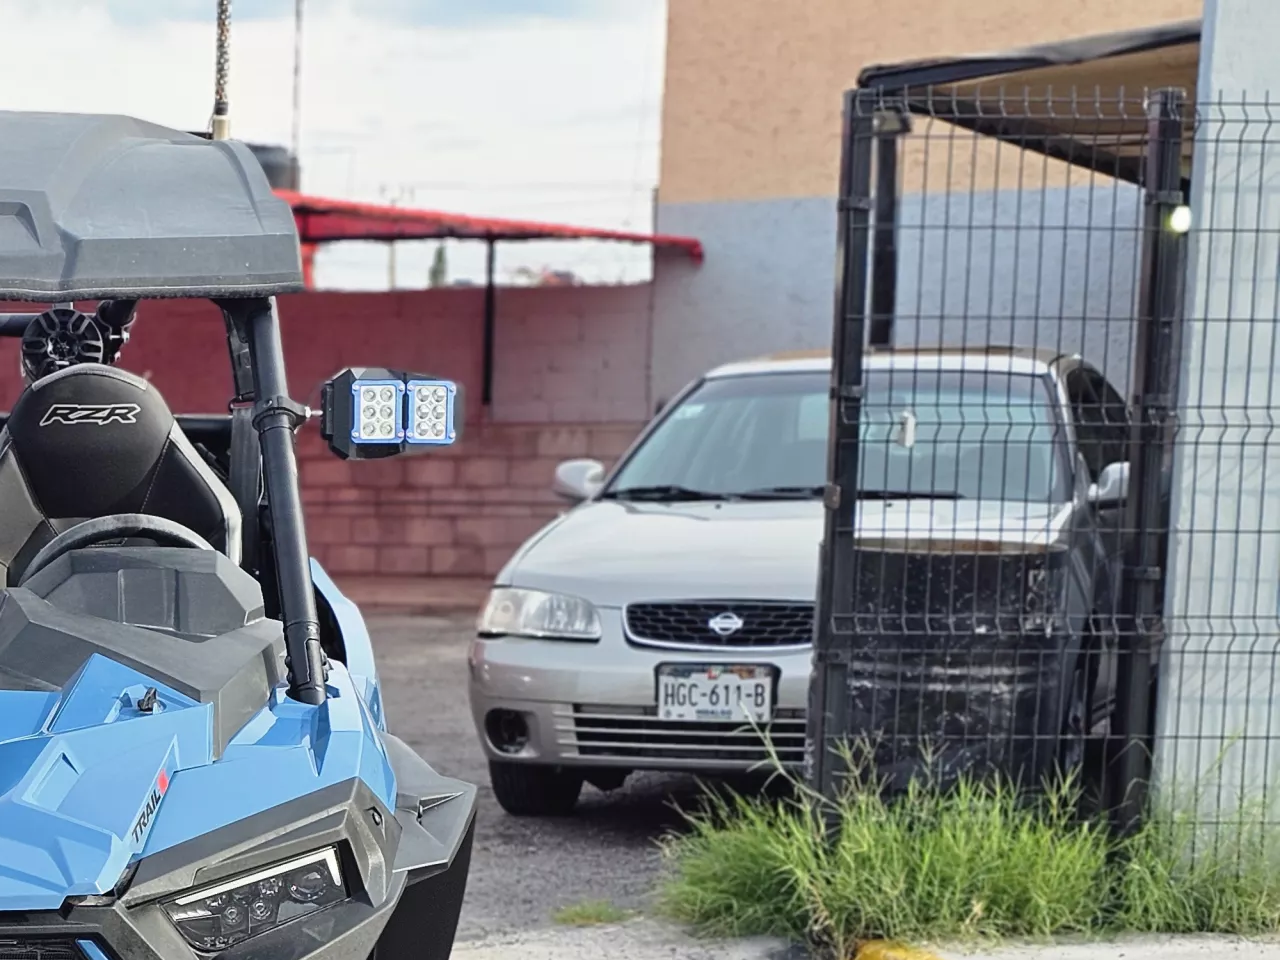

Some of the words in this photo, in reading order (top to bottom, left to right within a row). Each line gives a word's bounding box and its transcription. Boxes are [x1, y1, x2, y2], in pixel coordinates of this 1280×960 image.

[40, 403, 141, 426] RZR
[664, 682, 766, 707] HGC-611-B
[131, 789, 161, 843] TRAIL
